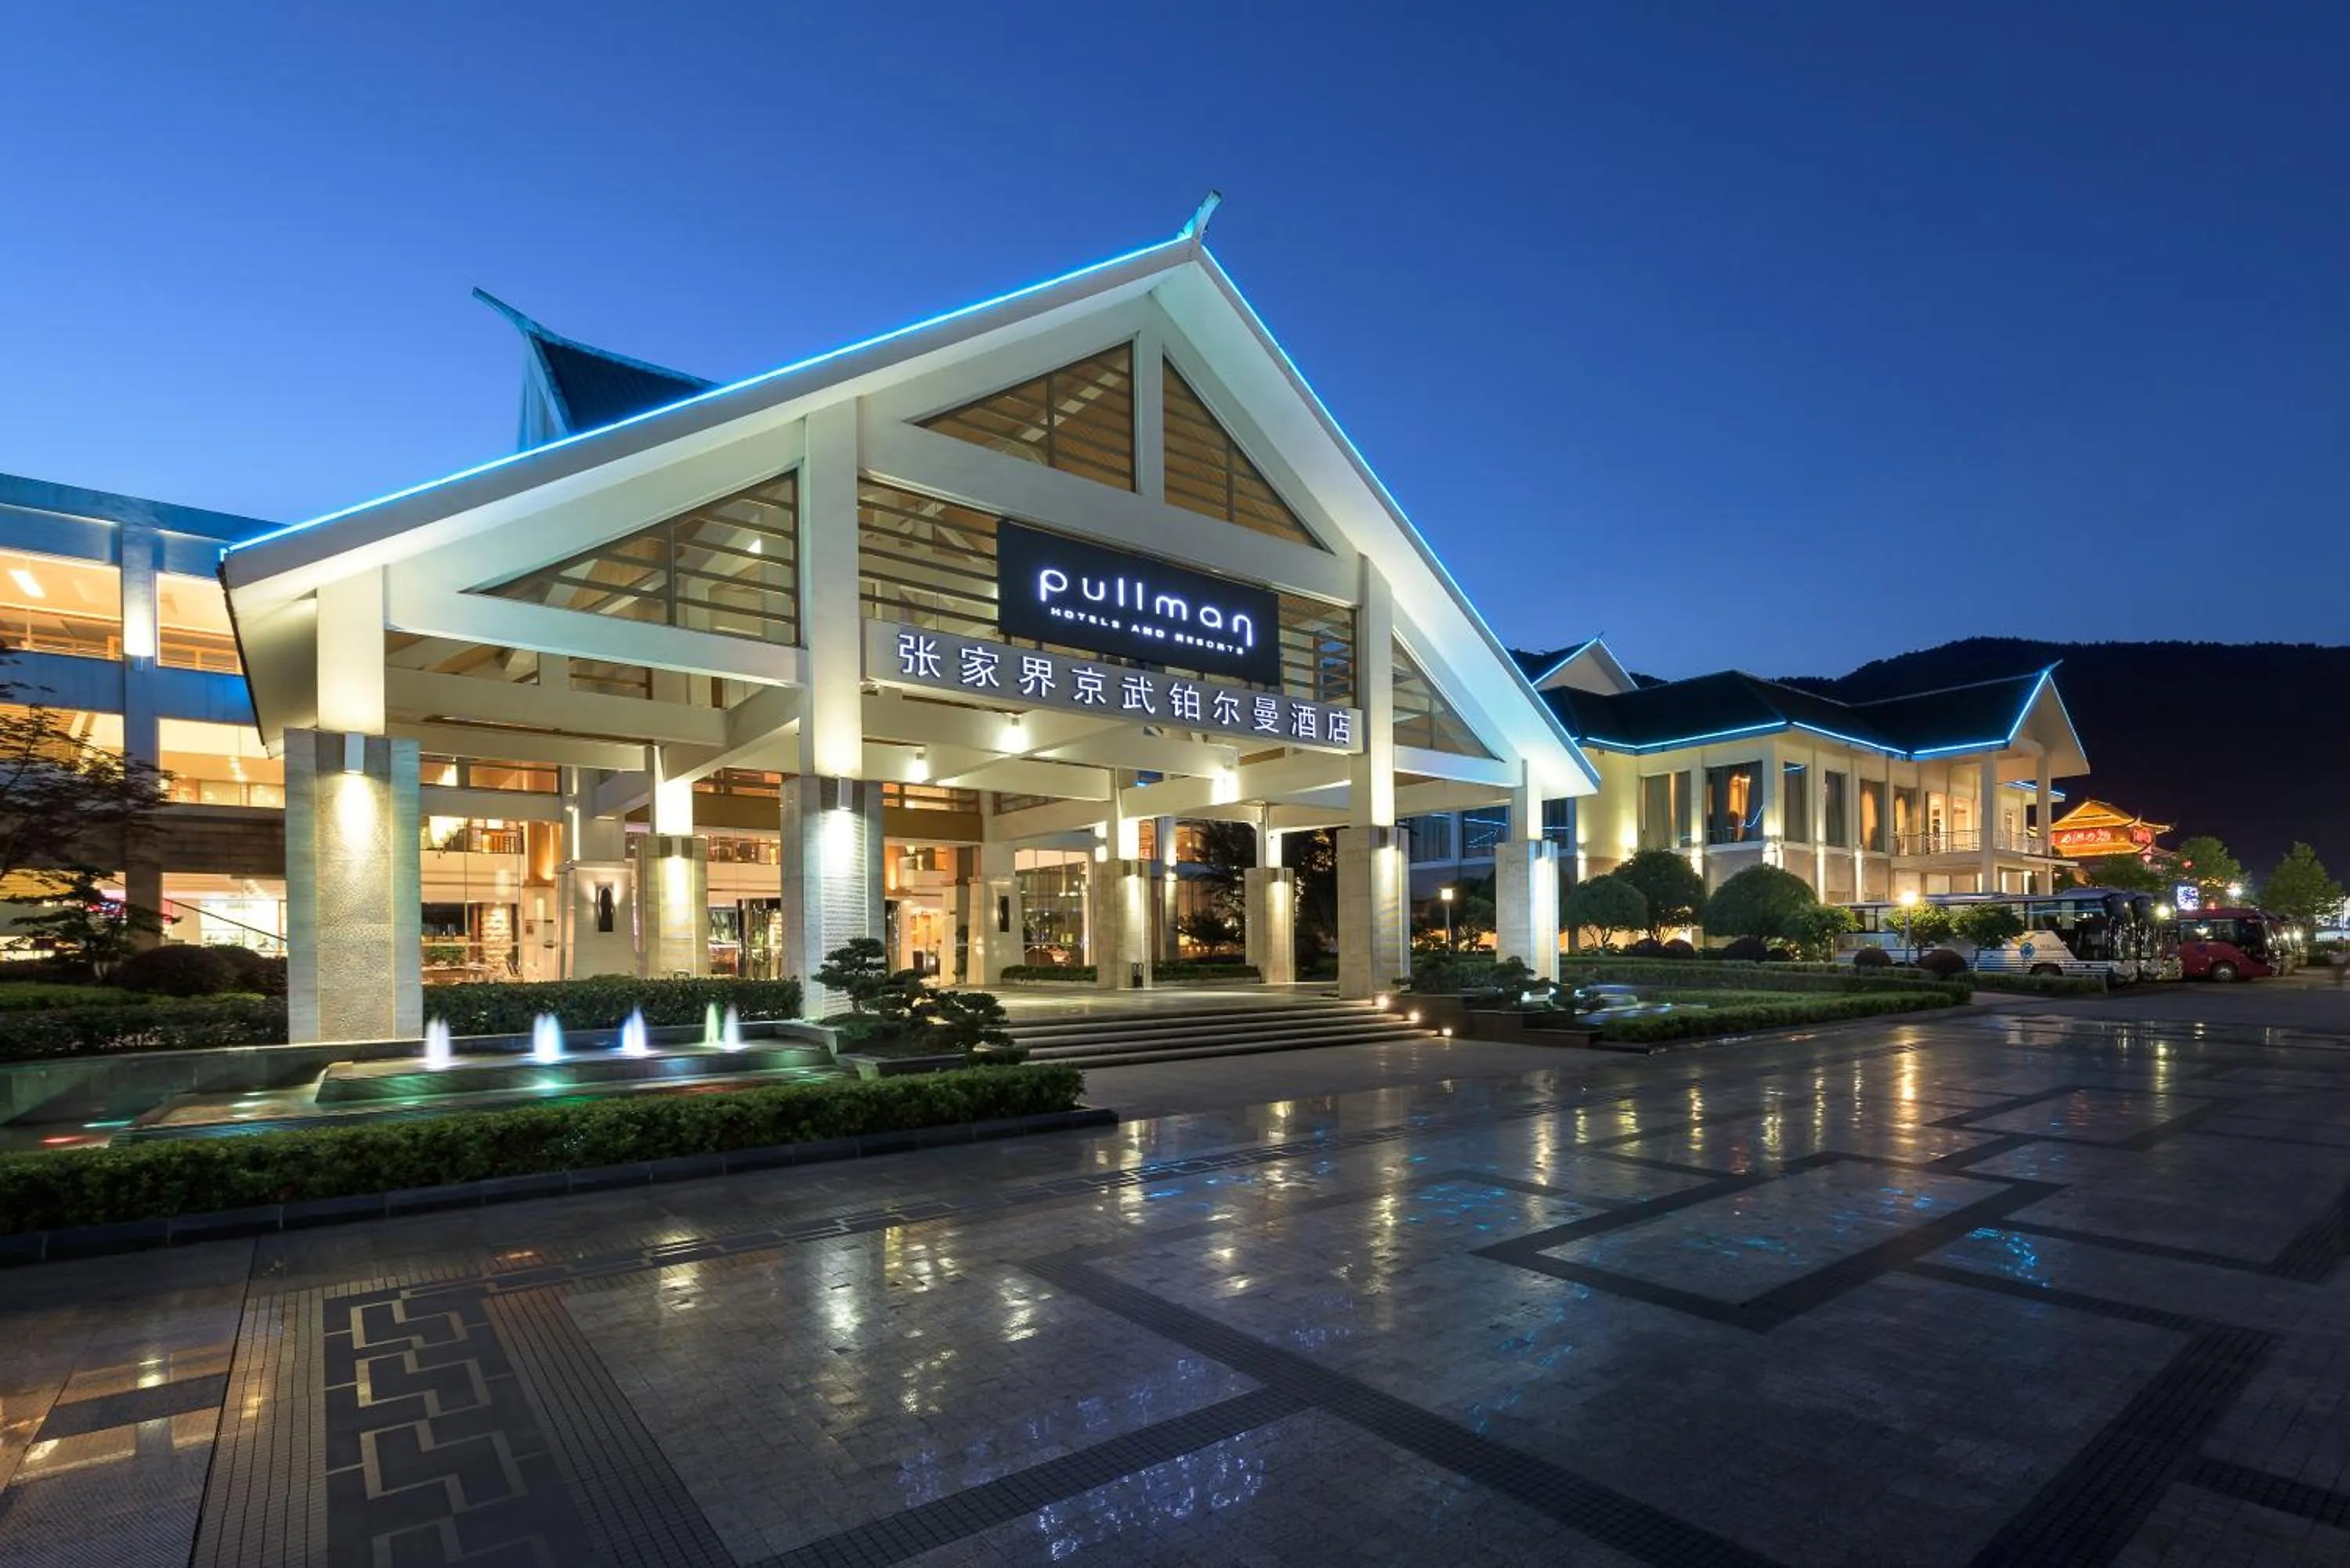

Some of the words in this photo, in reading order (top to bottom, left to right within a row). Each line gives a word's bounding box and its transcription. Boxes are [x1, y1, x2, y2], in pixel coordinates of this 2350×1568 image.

[1039, 569, 1253, 647] pullman
[1050, 607, 1120, 629] HOTELS
[1130, 624, 1165, 638] AND
[1174, 633, 1244, 655] RESORTS
[897, 633, 1353, 744] 张家界京武铂尔曼酒店
